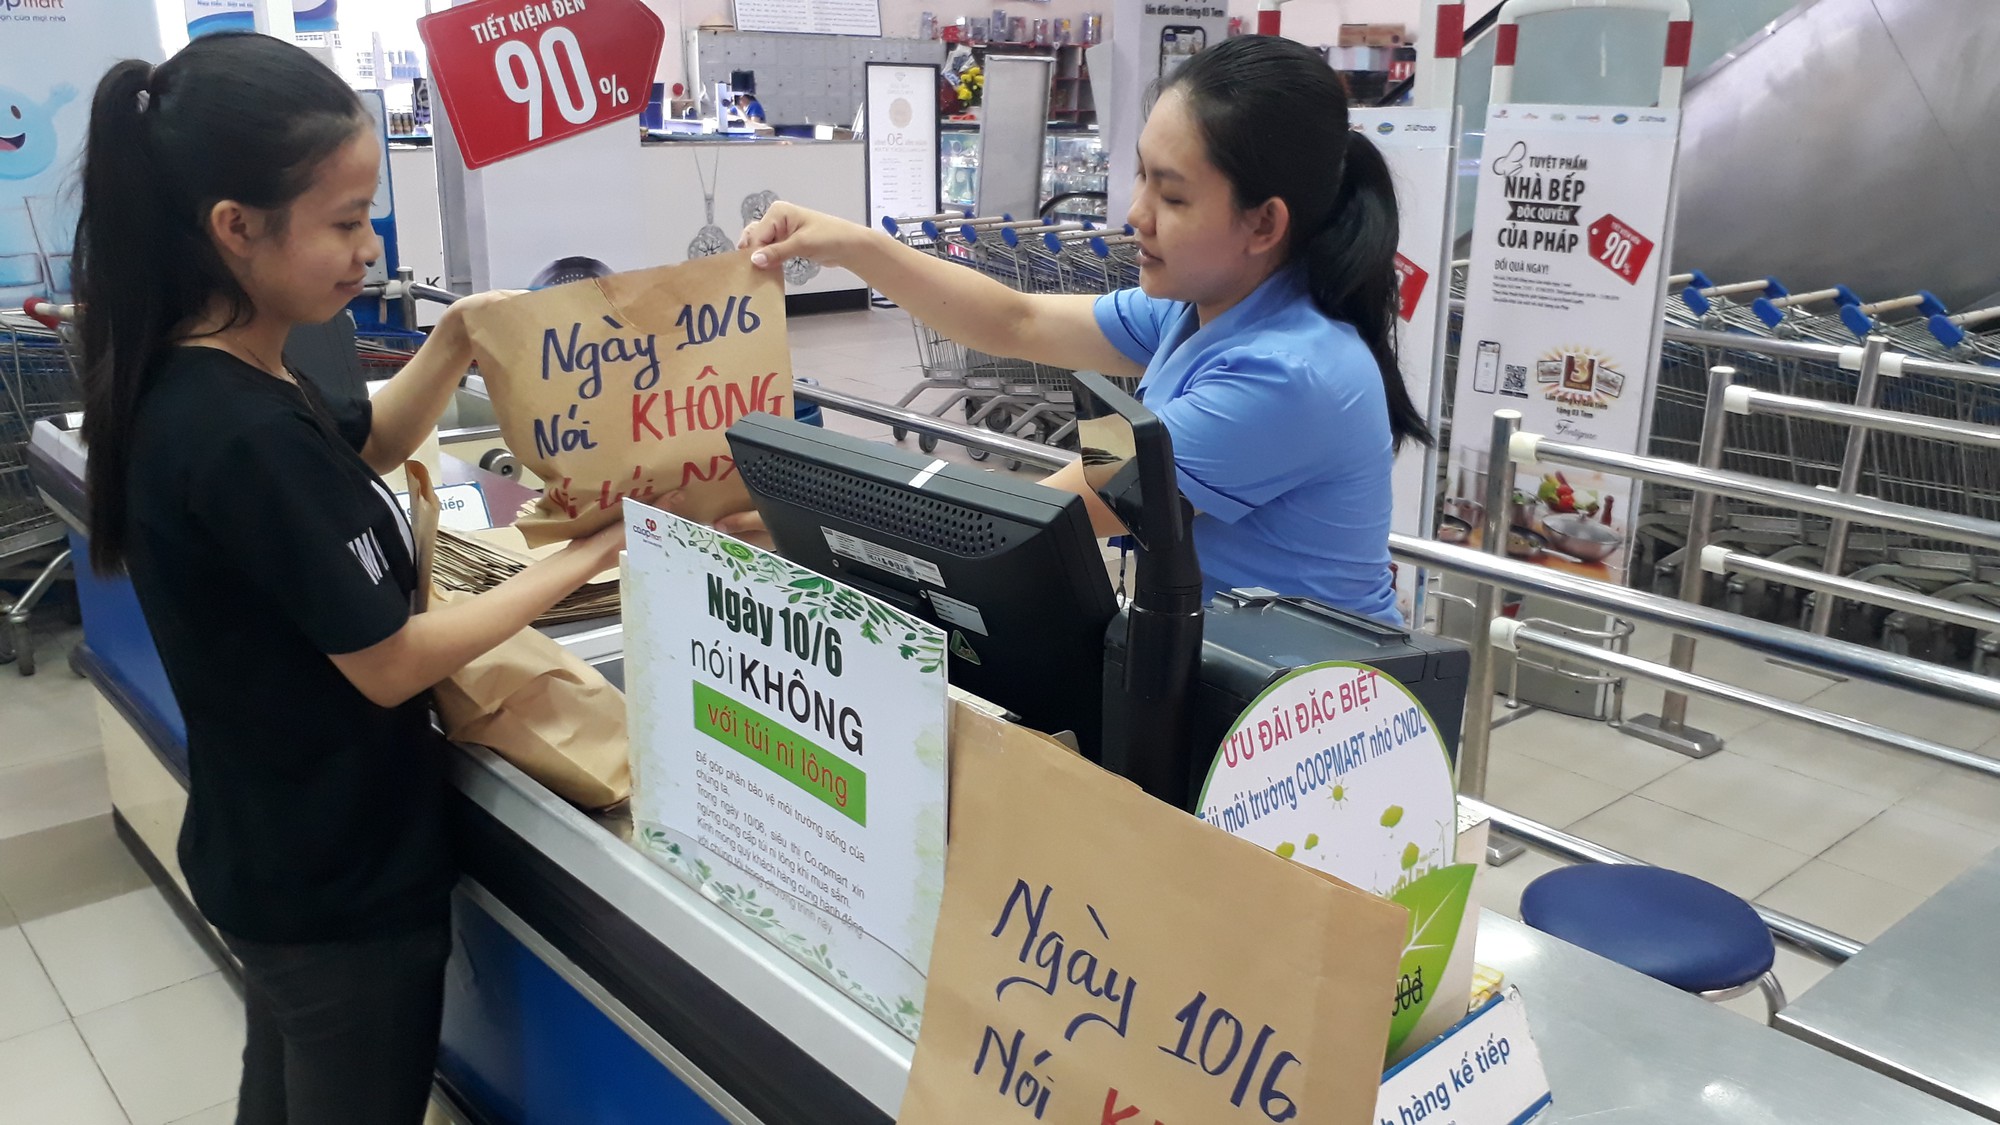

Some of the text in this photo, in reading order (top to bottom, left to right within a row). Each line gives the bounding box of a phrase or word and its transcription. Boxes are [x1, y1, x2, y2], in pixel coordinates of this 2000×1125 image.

[470, 14, 507, 44] TIẾT
[509, 5, 551, 32] KIỆM
[1504, 172, 1585, 202] NHÀ BẾP
[1529, 155, 1557, 172] TUYỆT
[1497, 222, 1528, 249] CỦA
[1533, 228, 1579, 254] PHÁP
[1516, 204, 1537, 222] ĐỘC
[541, 295, 761, 399] Ngày 10/6
[533, 365, 785, 459] Nói KHÔNG
[707, 573, 773, 647] Ngày
[779, 607, 843, 678] 10/6
[691, 638, 863, 756] nói KHÔNG
[1222, 668, 1380, 768] ƯU ĐÃI ĐẶC BIỆT
[707, 704, 848, 807] với túi ni lông
[1223, 792, 1249, 833] môi
[1248, 776, 1297, 820] trường
[1296, 731, 1368, 795] COOPMART
[1368, 717, 1392, 759] nhỏ
[1393, 705, 1427, 746] CNDL
[697, 783, 718, 807] Trong
[721, 800, 740, 819] ngày
[770, 831, 787, 848] siêu
[804, 850, 848, 888] Co.opmart
[851, 883, 865, 900] xin
[709, 759, 724, 775] góp
[726, 770, 746, 788] phần
[748, 780, 763, 797] bảo
[765, 793, 776, 807] vệ
[777, 800, 793, 816] môi
[794, 809, 823, 838] trường
[825, 830, 847, 853] sống
[849, 845, 865, 863] của
[742, 831, 757, 848] cấp
[778, 850, 796, 874] lông
[810, 874, 829, 893] mua
[990, 878, 1302, 1123] Ngày 10/6
[973, 1025, 1055, 1121] Nói
[1398, 1033, 1511, 1125] hàng kế tiếp
